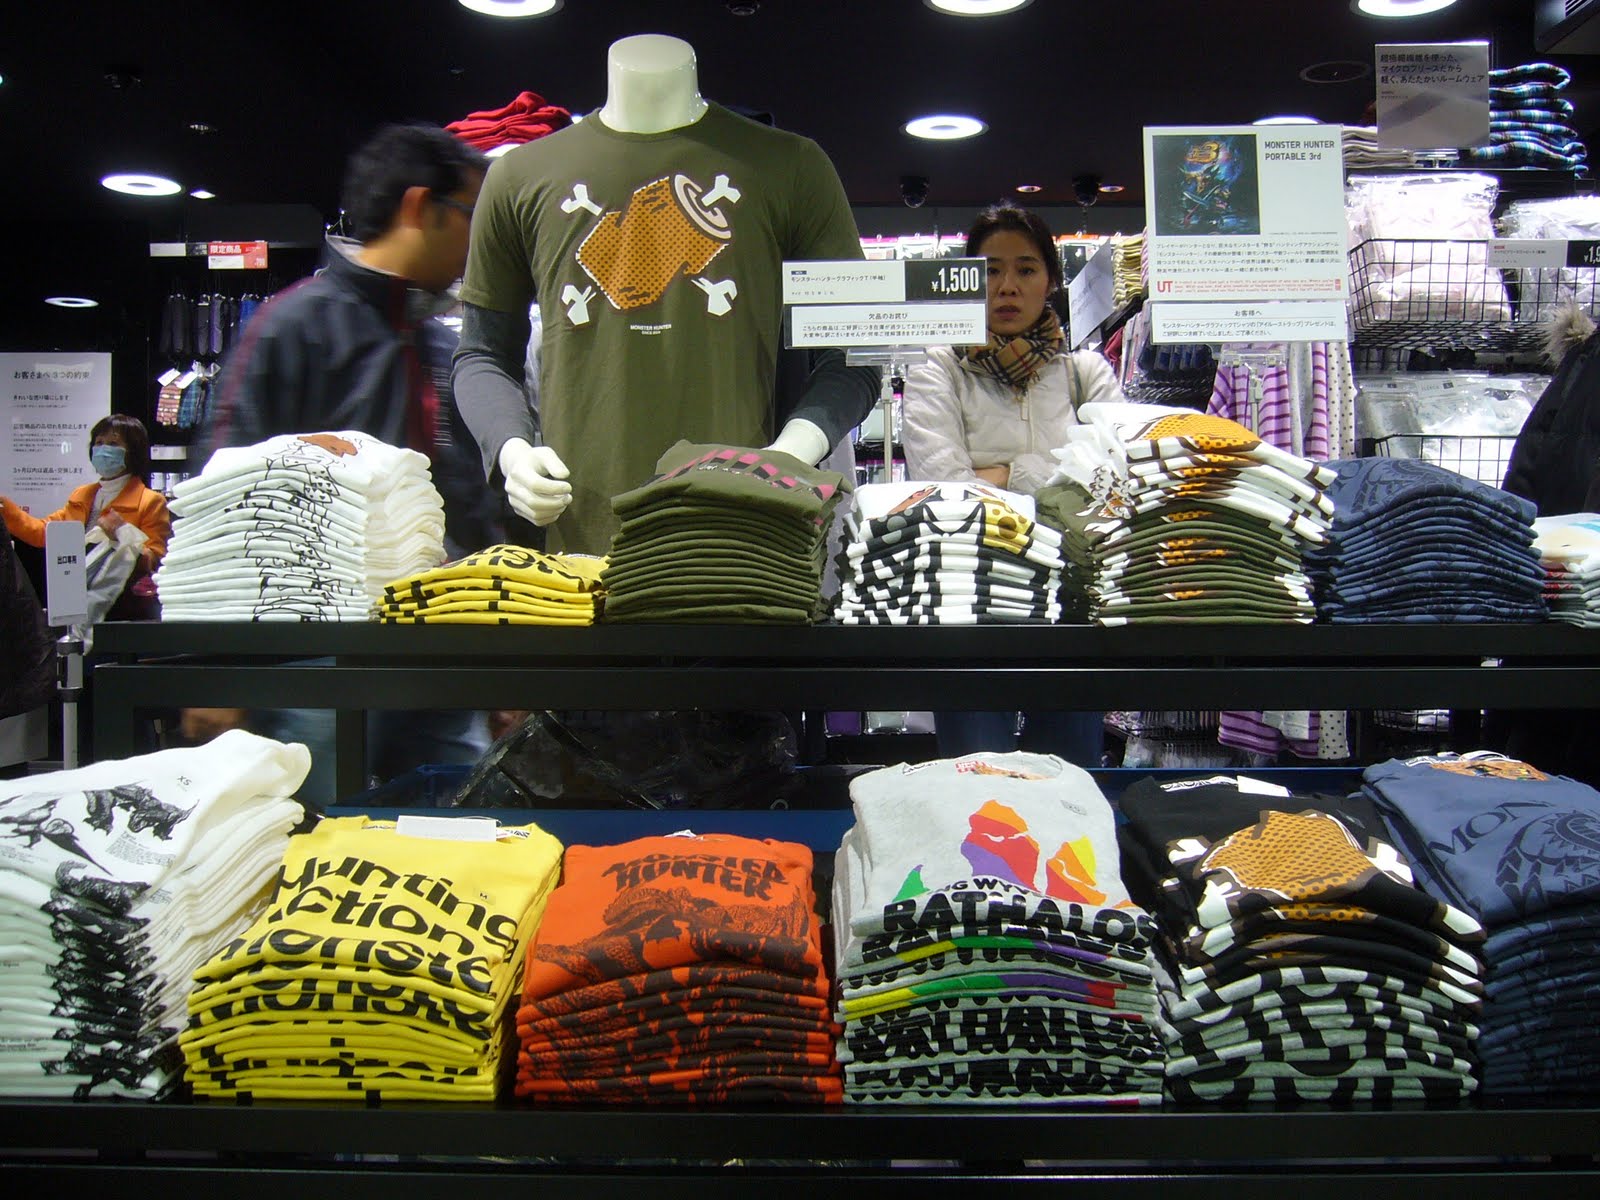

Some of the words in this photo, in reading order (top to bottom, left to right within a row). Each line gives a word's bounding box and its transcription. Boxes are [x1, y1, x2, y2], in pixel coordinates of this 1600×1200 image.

[1381, 65, 1462, 73] マイクロフリースだから
[1265, 141, 1300, 149] MONSTER
[1303, 140, 1335, 149] HUNTER
[1265, 152, 1306, 161] PORTABLE
[1309, 152, 1322, 161] 3rd
[210, 245, 242, 254] 限定商品
[931, 267, 980, 295] ¥1,500
[1157, 280, 1173, 293] UT
[177, 775, 193, 787] XS
[268, 886, 476, 956] ction
